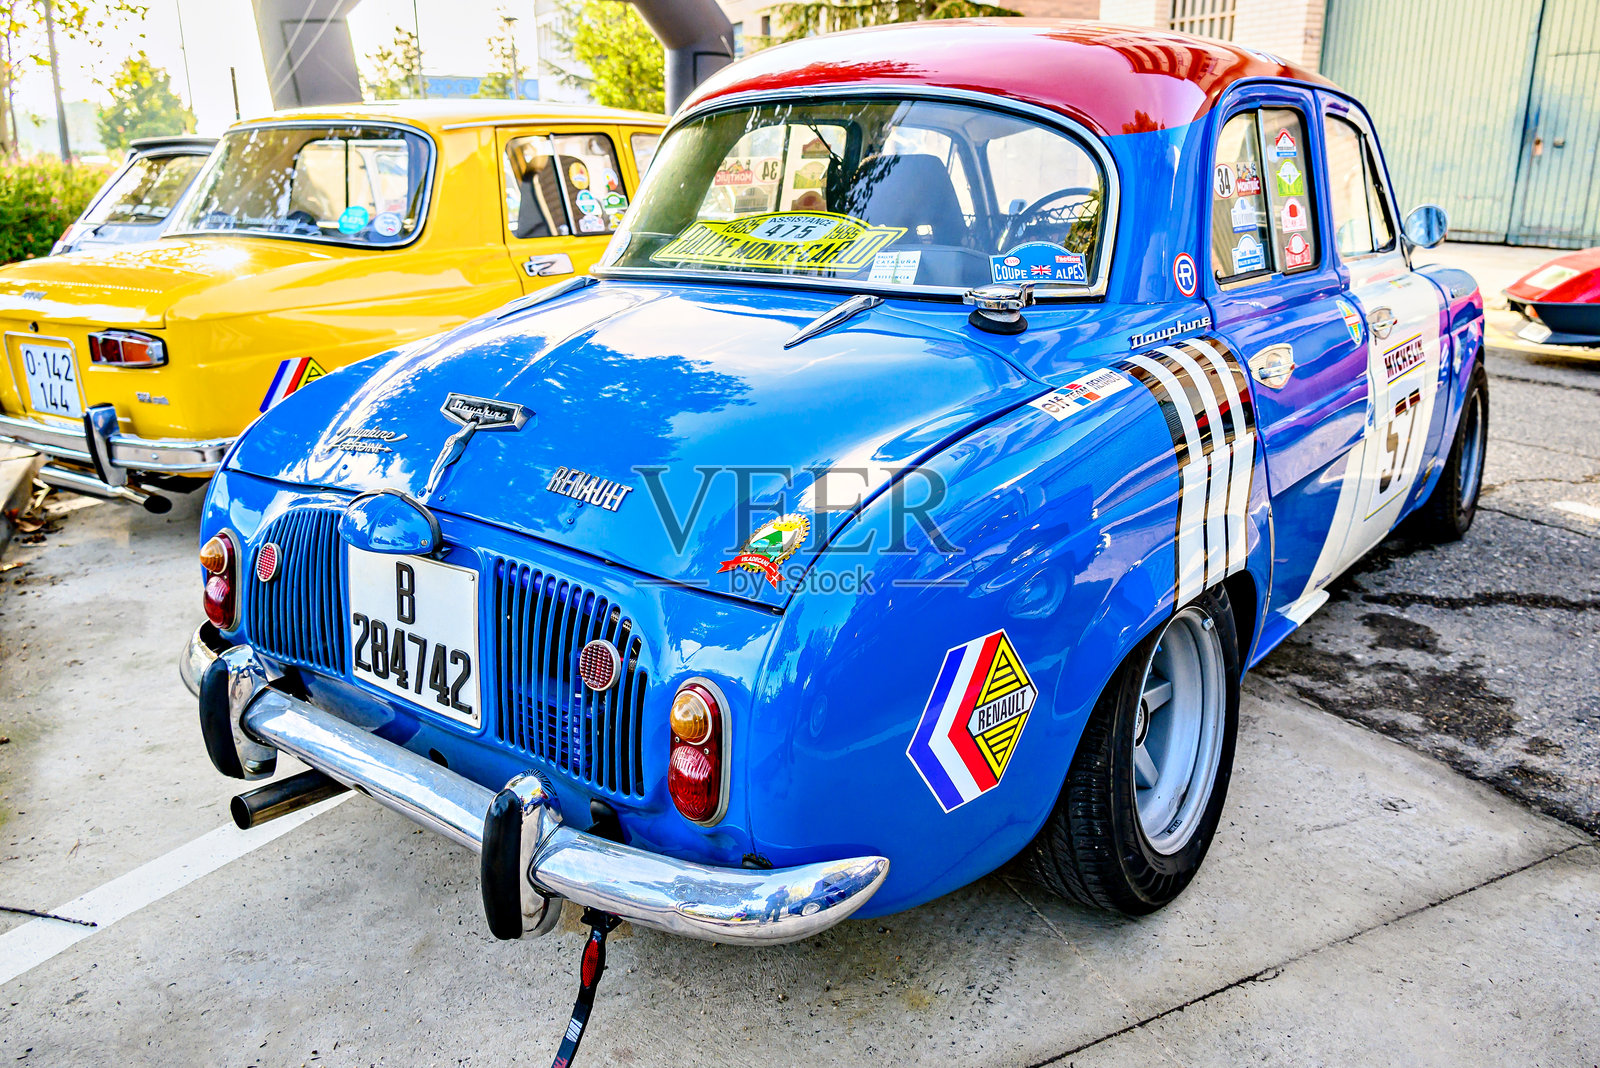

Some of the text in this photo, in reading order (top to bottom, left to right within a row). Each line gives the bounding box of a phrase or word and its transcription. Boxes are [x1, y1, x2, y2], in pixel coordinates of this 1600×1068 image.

[1217, 167, 1231, 195] 34
[765, 223, 817, 239] 475
[768, 214, 835, 227] ASSISTANCE
[824, 222, 861, 240] 1985
[668, 224, 741, 257] RALLYE
[728, 233, 890, 265] MONTE-CARLO
[994, 263, 1086, 281] COUPE ALPES
[1130, 315, 1212, 350] Dauphine
[1384, 339, 1425, 378] MICHELIN
[40, 382, 69, 411] 144
[451, 399, 508, 421] Dauphine
[1041, 395, 1070, 413] elf
[1064, 386, 1090, 401] TEAM
[1379, 388, 1420, 494] 57
[546, 466, 634, 513] RENAULT
[396, 560, 416, 625] B
[353, 612, 473, 715] 284742
[978, 689, 1027, 732] RENAULT
